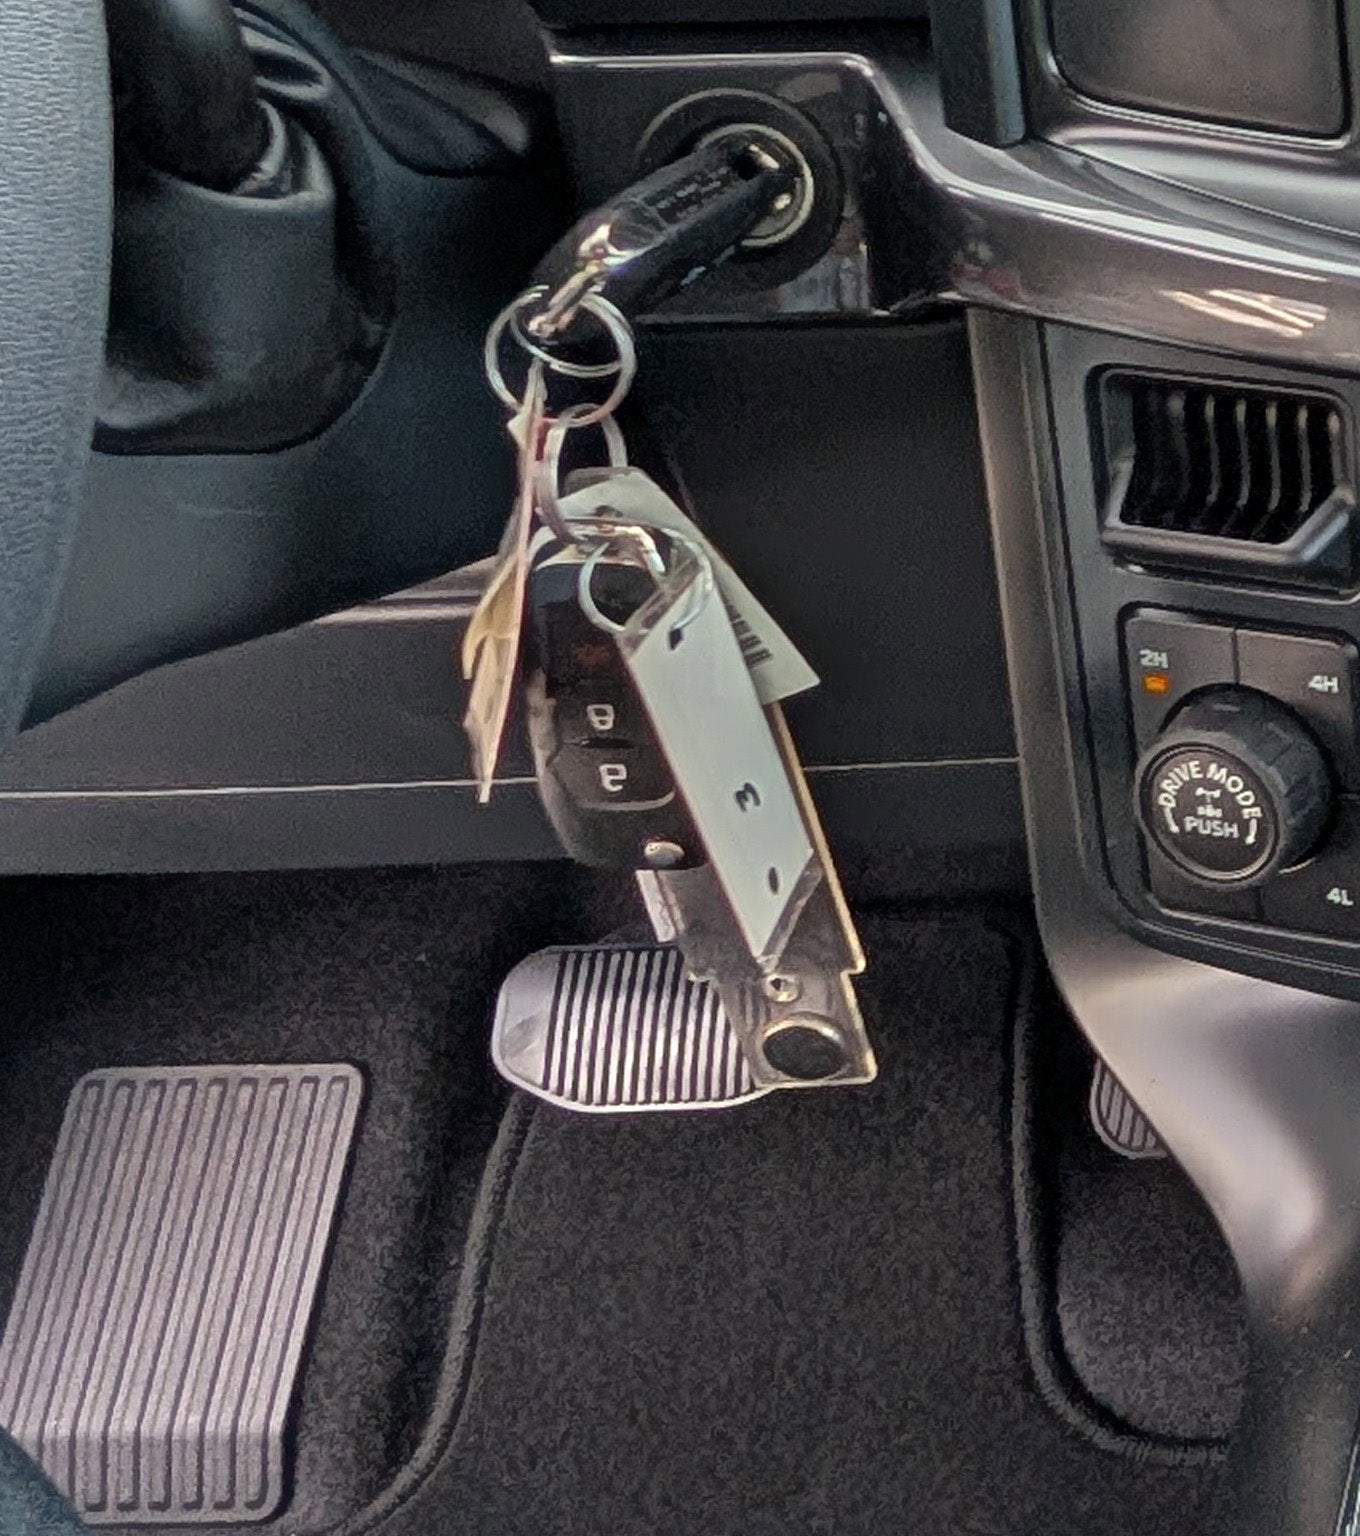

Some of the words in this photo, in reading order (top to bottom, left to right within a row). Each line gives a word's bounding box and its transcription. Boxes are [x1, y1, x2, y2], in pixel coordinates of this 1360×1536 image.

[1140, 649, 1168, 668] 2H
[1308, 675, 1339, 693] 4H
[1158, 760, 1202, 808] DRIVE
[1207, 763, 1263, 820] MODE
[1184, 816, 1240, 839] PUSH
[1327, 887, 1353, 907] 4L
